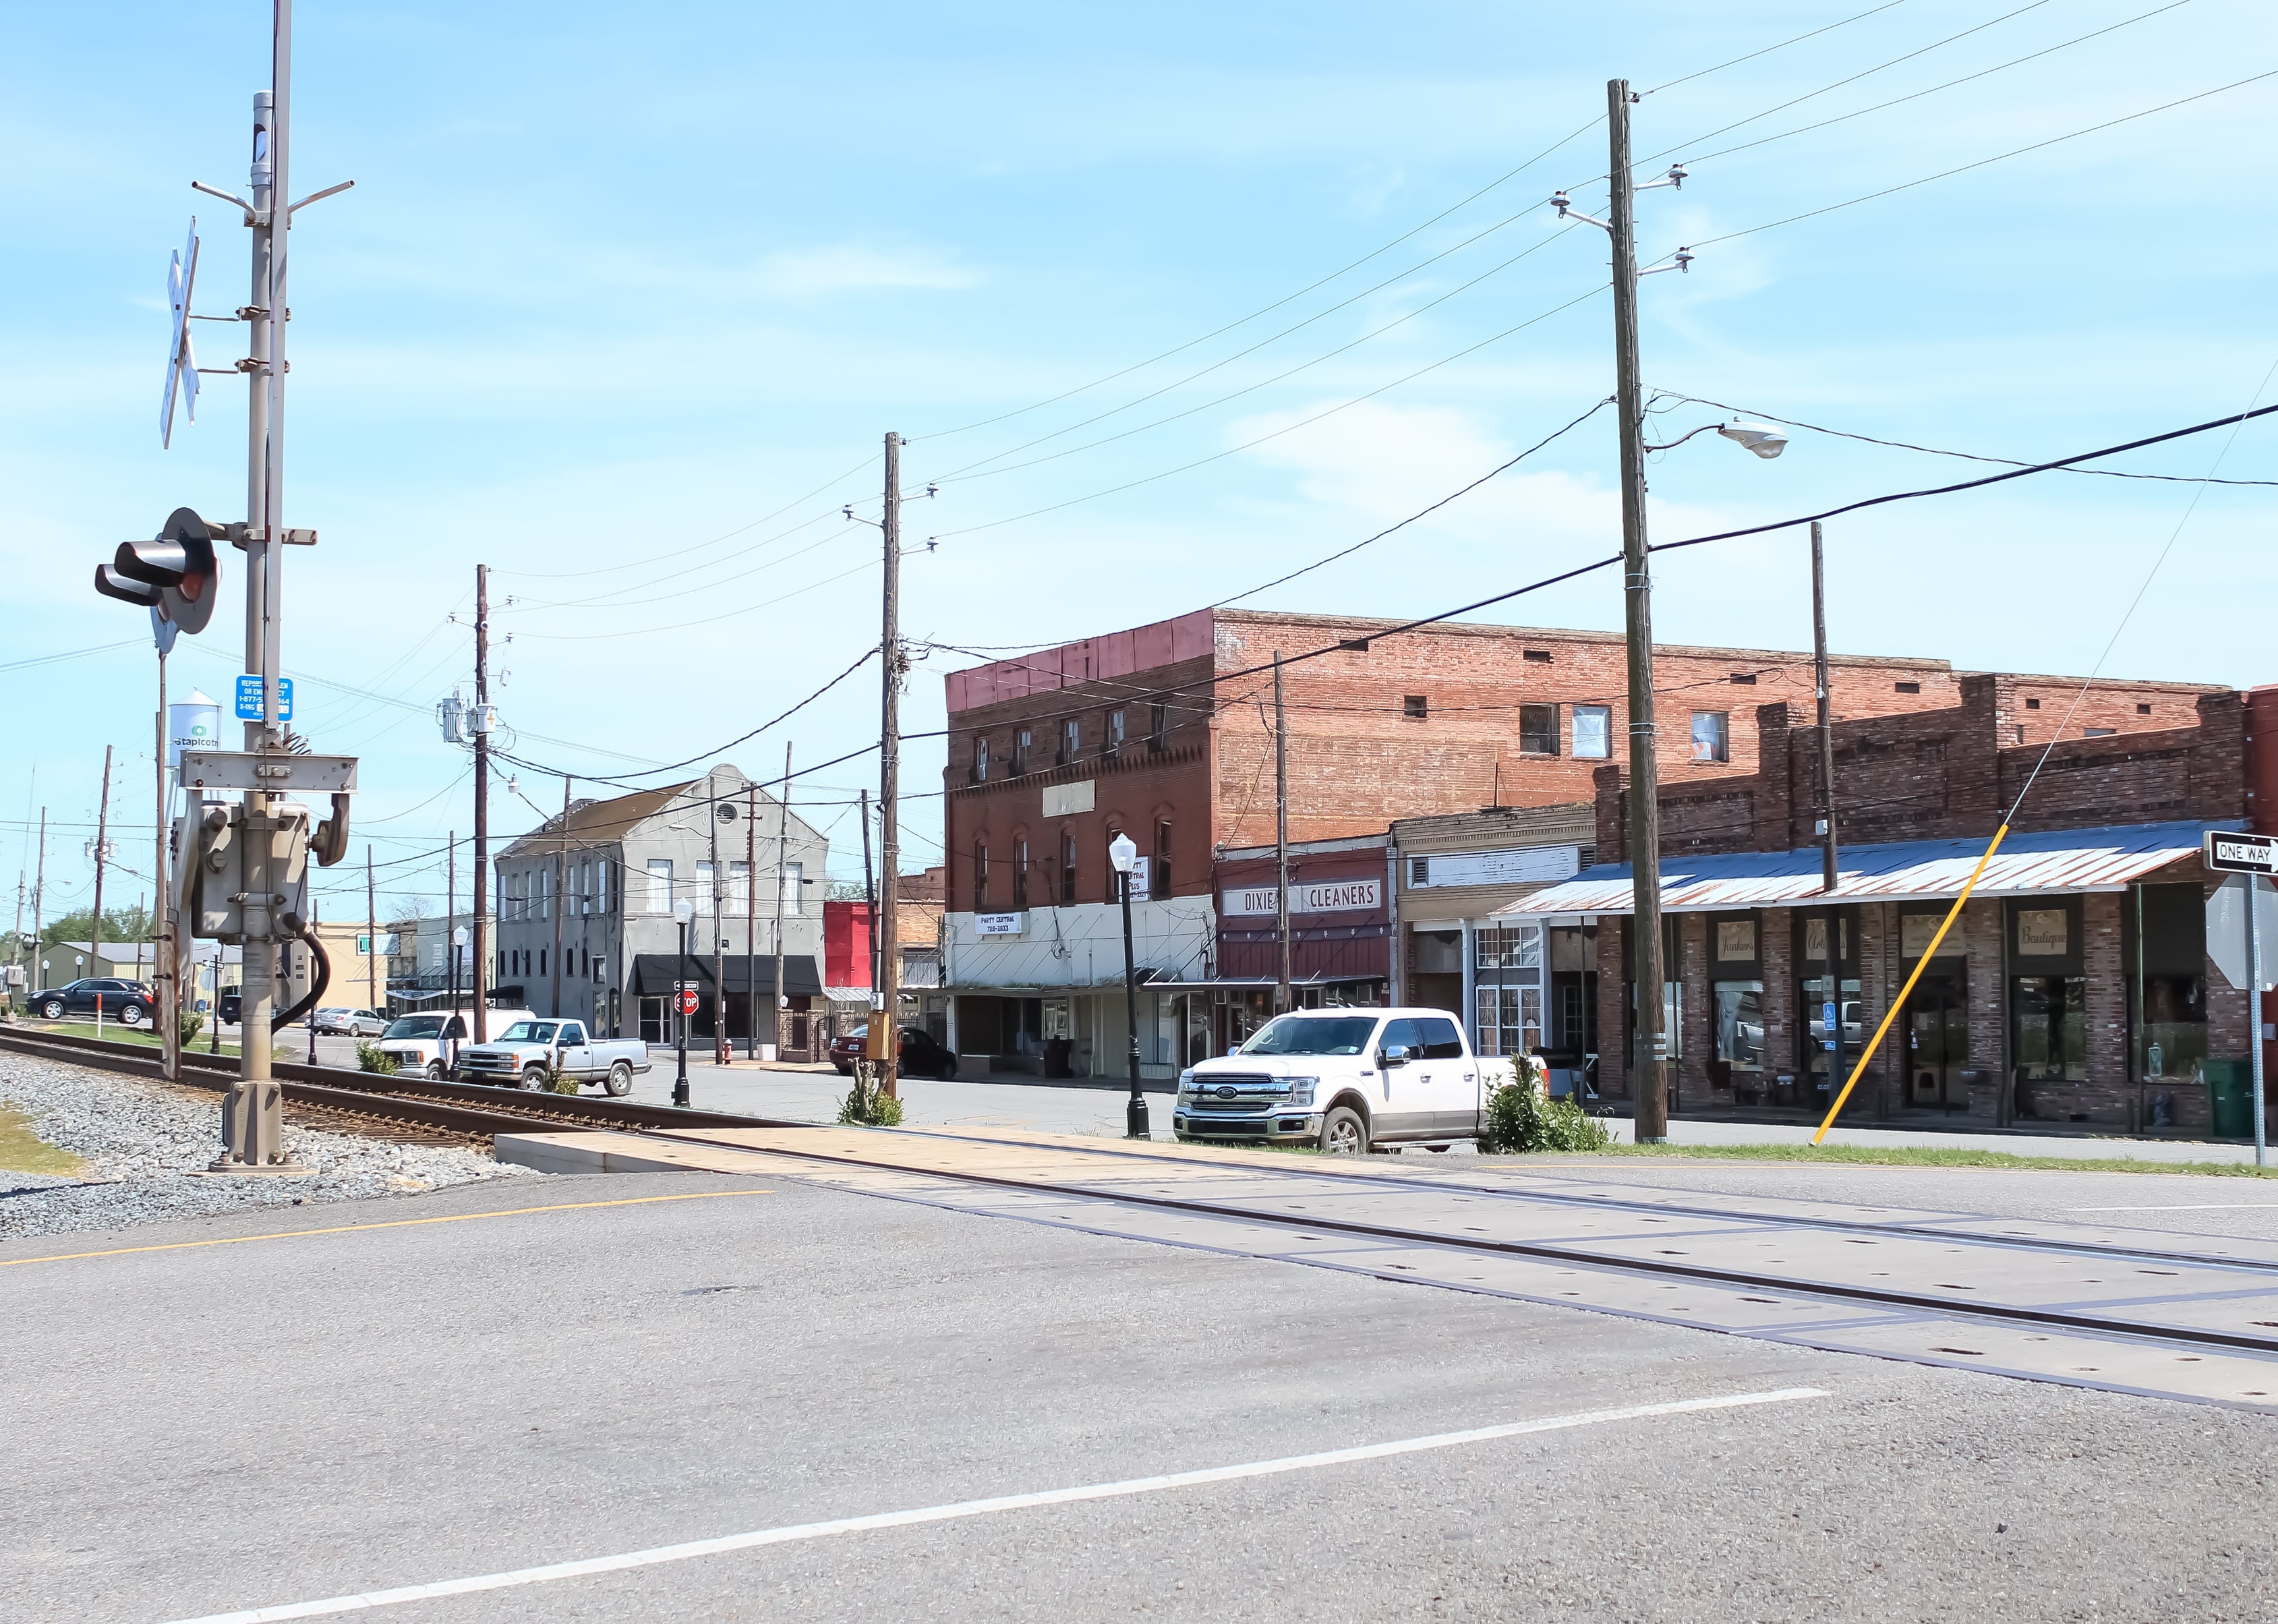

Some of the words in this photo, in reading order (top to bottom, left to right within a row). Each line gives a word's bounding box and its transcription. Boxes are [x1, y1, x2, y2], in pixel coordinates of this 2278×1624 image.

[2220, 844, 2243, 859] ONE
[2247, 846, 2271, 862] WAY
[1245, 892, 1273, 910] DIXIE
[1310, 884, 1374, 907] CLEANERS
[2022, 925, 2066, 950] Boutique
